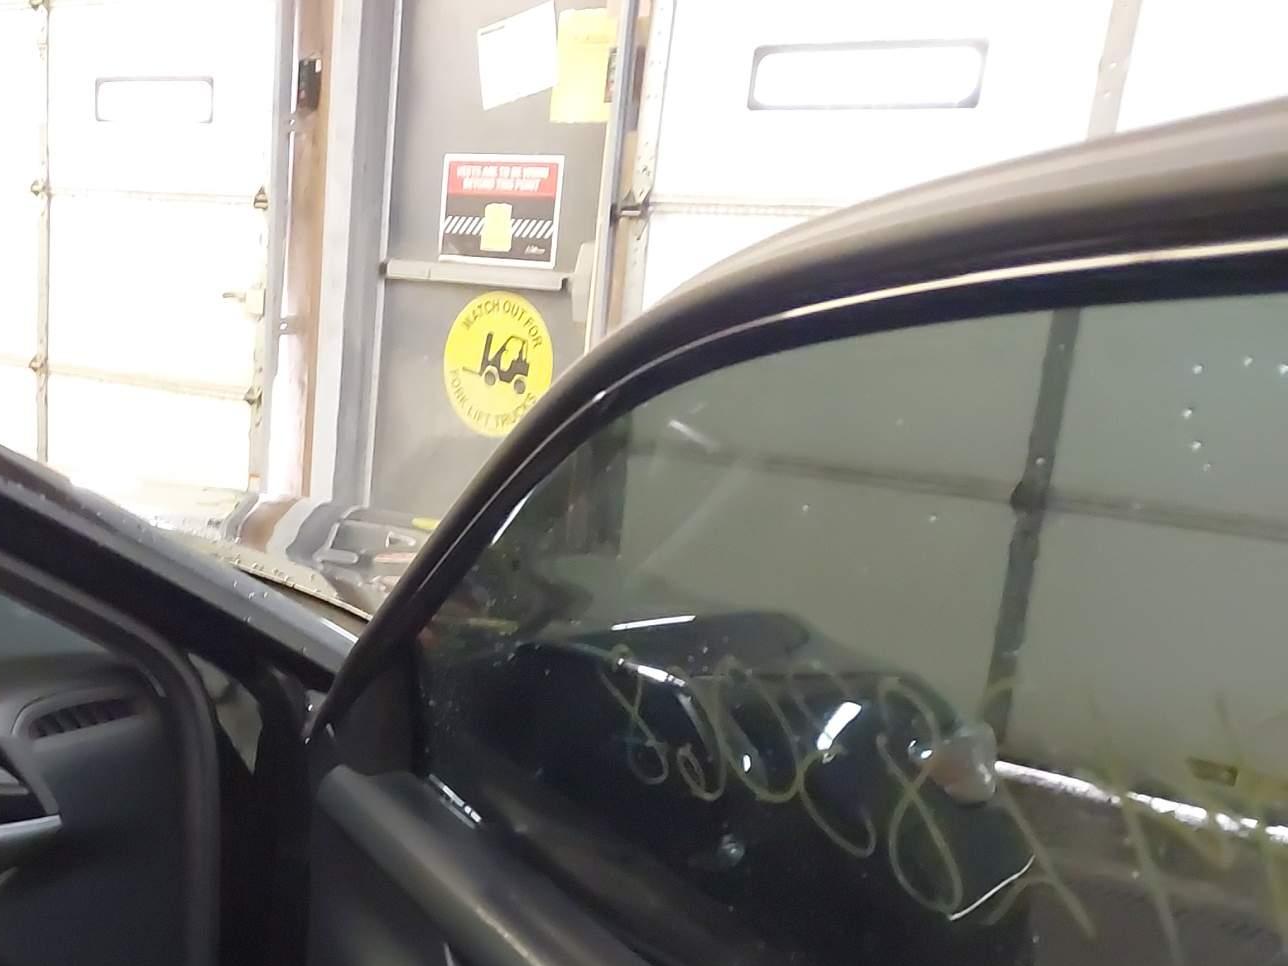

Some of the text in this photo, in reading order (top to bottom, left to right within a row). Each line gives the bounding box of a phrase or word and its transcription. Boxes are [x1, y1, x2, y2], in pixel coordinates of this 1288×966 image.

[461, 299, 543, 349] WATCH OUT FOR
